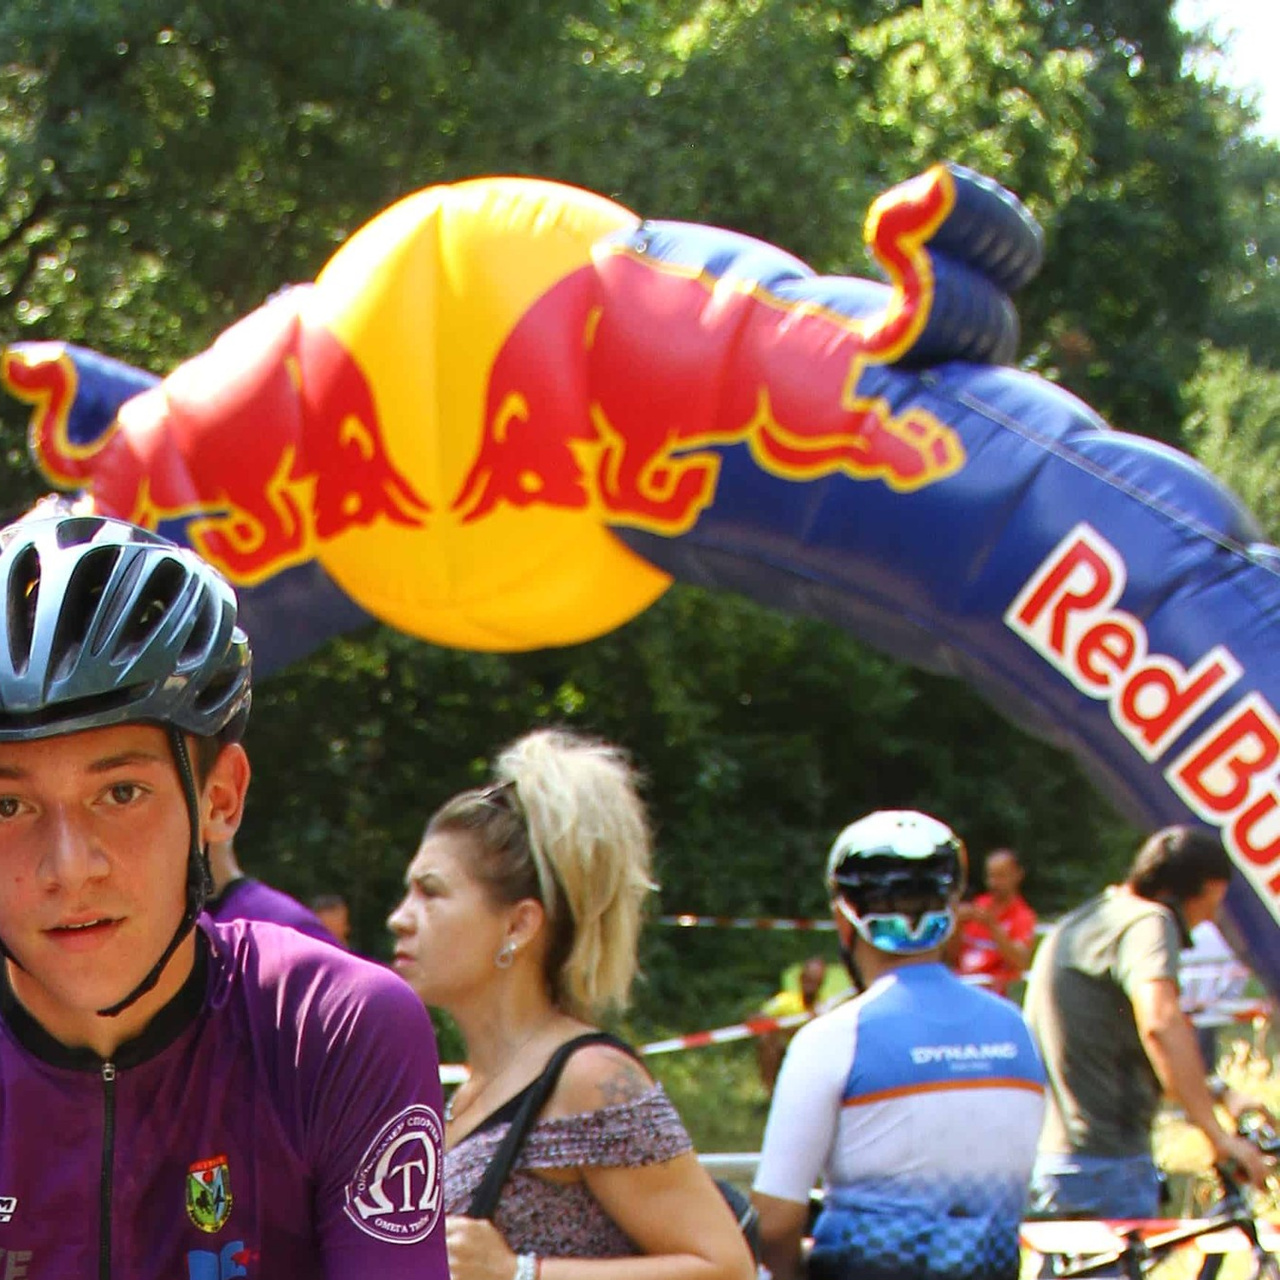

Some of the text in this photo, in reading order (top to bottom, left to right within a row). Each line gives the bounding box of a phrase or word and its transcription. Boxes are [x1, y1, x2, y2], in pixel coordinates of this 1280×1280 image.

[1007, 525, 1280, 926] Red Bu
[373, 1217, 410, 1234] ОМЕГА
